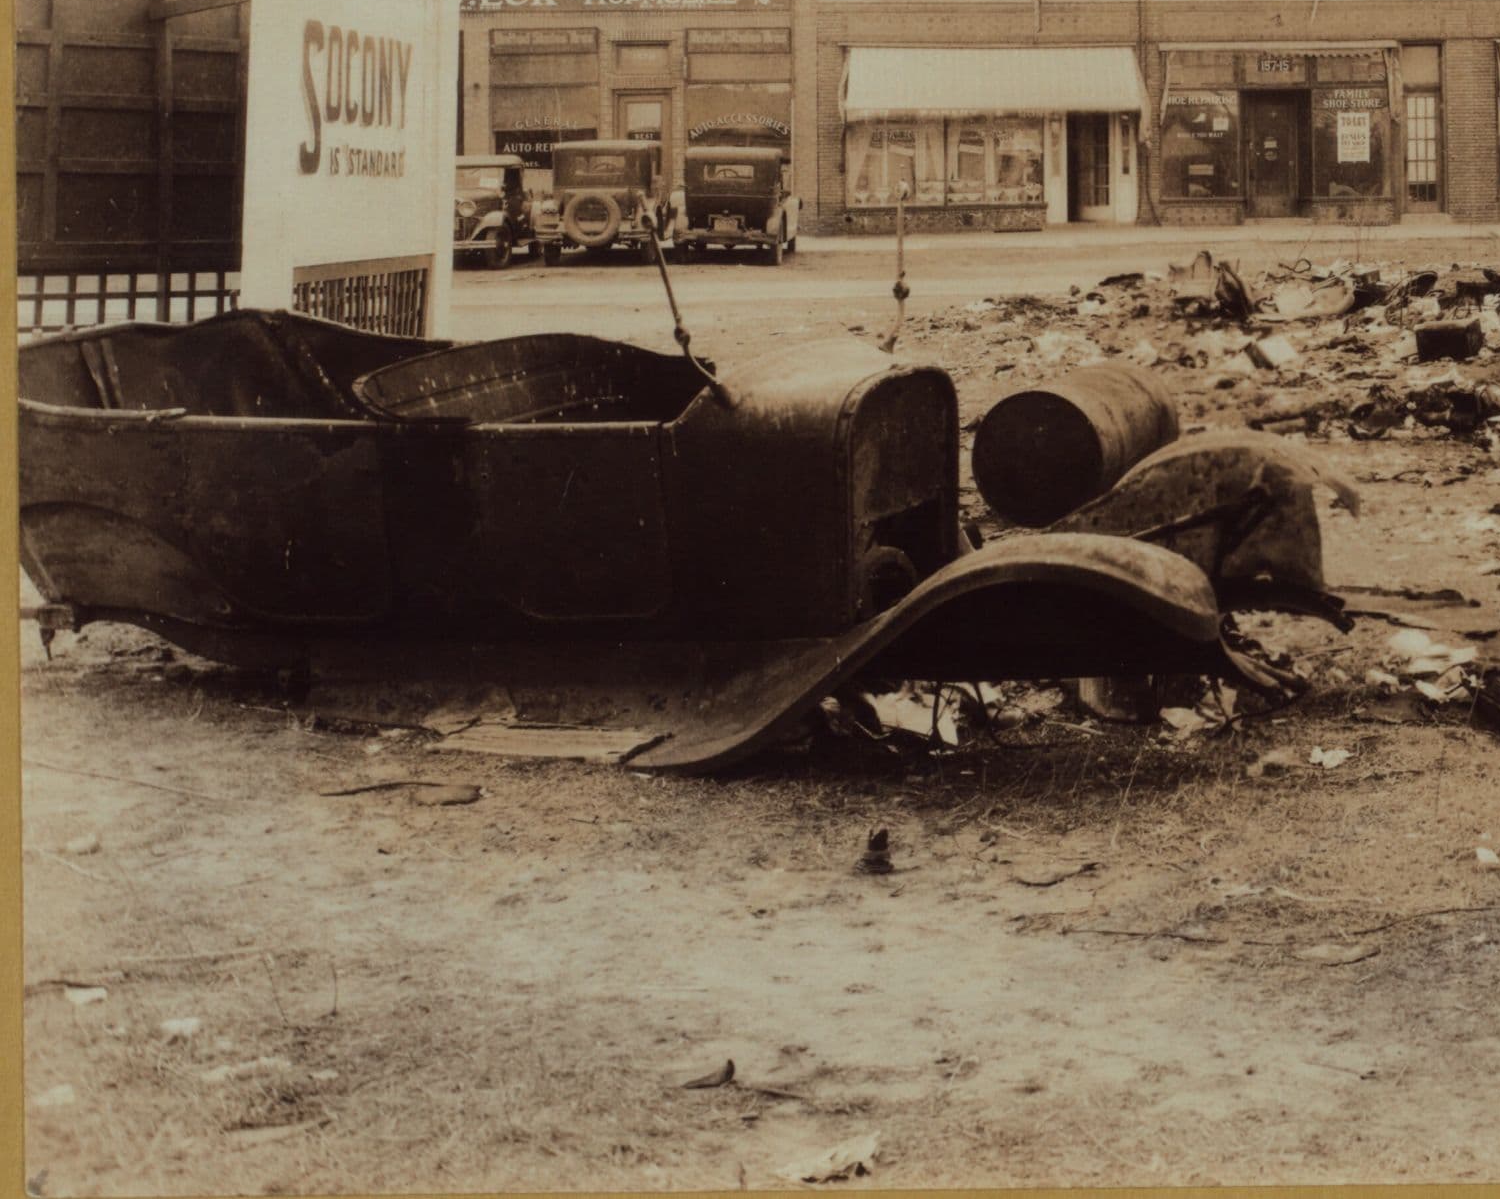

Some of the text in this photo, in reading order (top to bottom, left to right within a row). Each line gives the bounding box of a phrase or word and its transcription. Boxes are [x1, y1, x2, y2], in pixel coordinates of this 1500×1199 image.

[1261, 59, 1290, 73] 157-15
[299, 19, 413, 176] SOCONY
[1334, 89, 1369, 99] FAMILY
[1168, 95, 1187, 106] HOE
[1323, 98, 1382, 108] SHOE STORE
[502, 143, 532, 153] AUTO
[329, 146, 340, 176] IS
